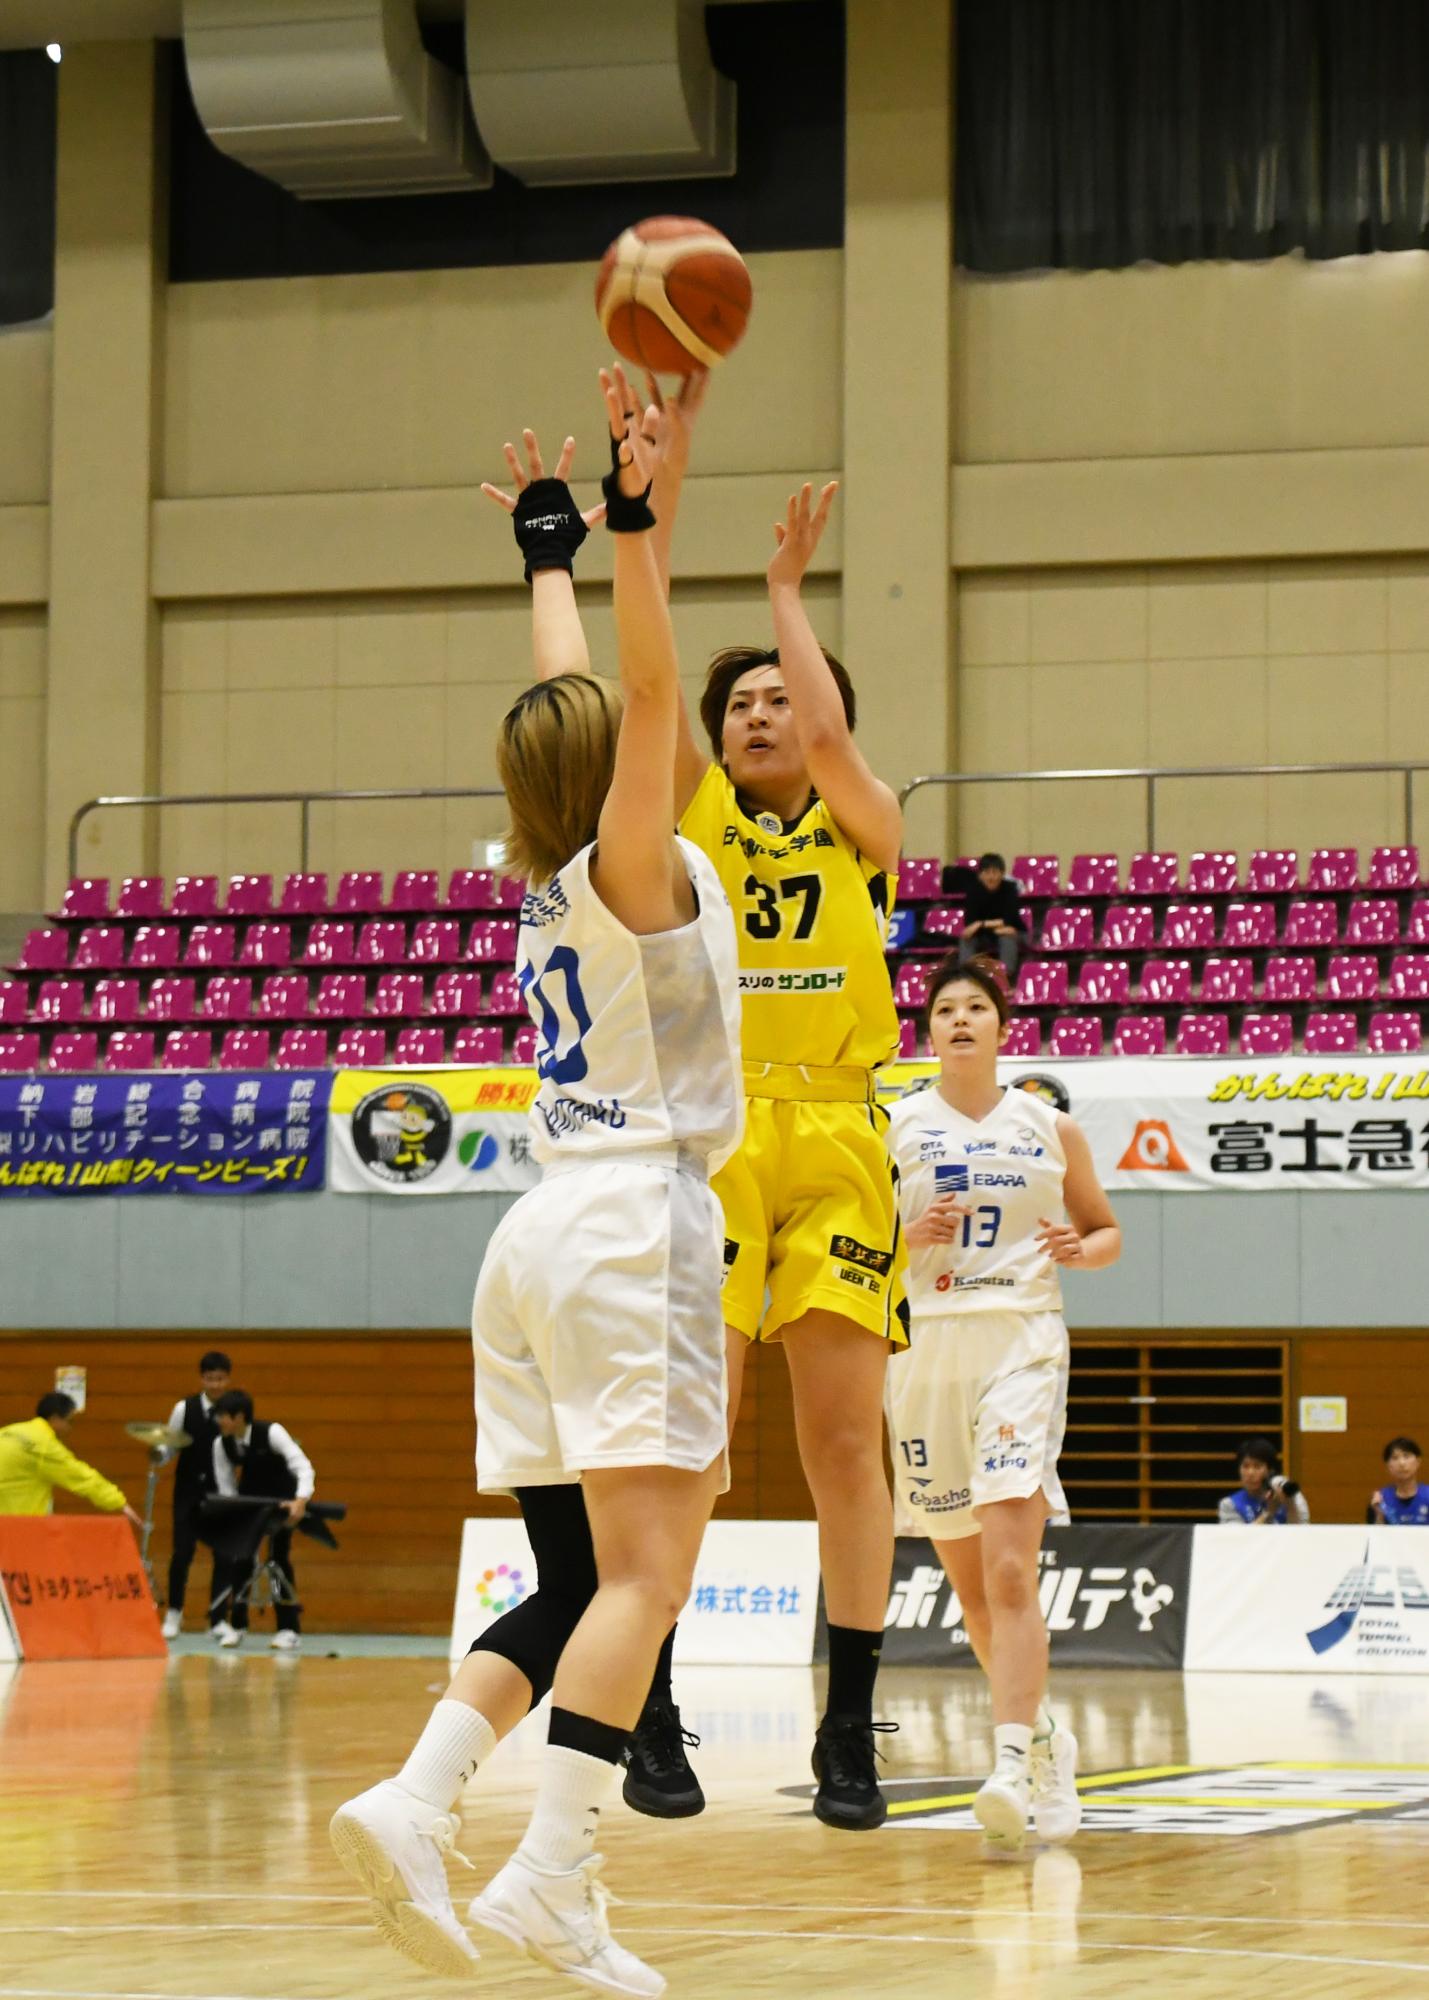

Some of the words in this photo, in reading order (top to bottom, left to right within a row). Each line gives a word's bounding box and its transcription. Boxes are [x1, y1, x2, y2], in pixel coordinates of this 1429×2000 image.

[744, 872, 822, 940] 37
[919, 1151, 946, 1162] CITY
[1208, 1119, 1429, 1172] 富士急
[973, 1174, 1027, 1188] EBARA
[961, 1205, 1003, 1248] 13
[900, 1438, 928, 1468] 13
[695, 1585, 801, 1614] 株式会社
